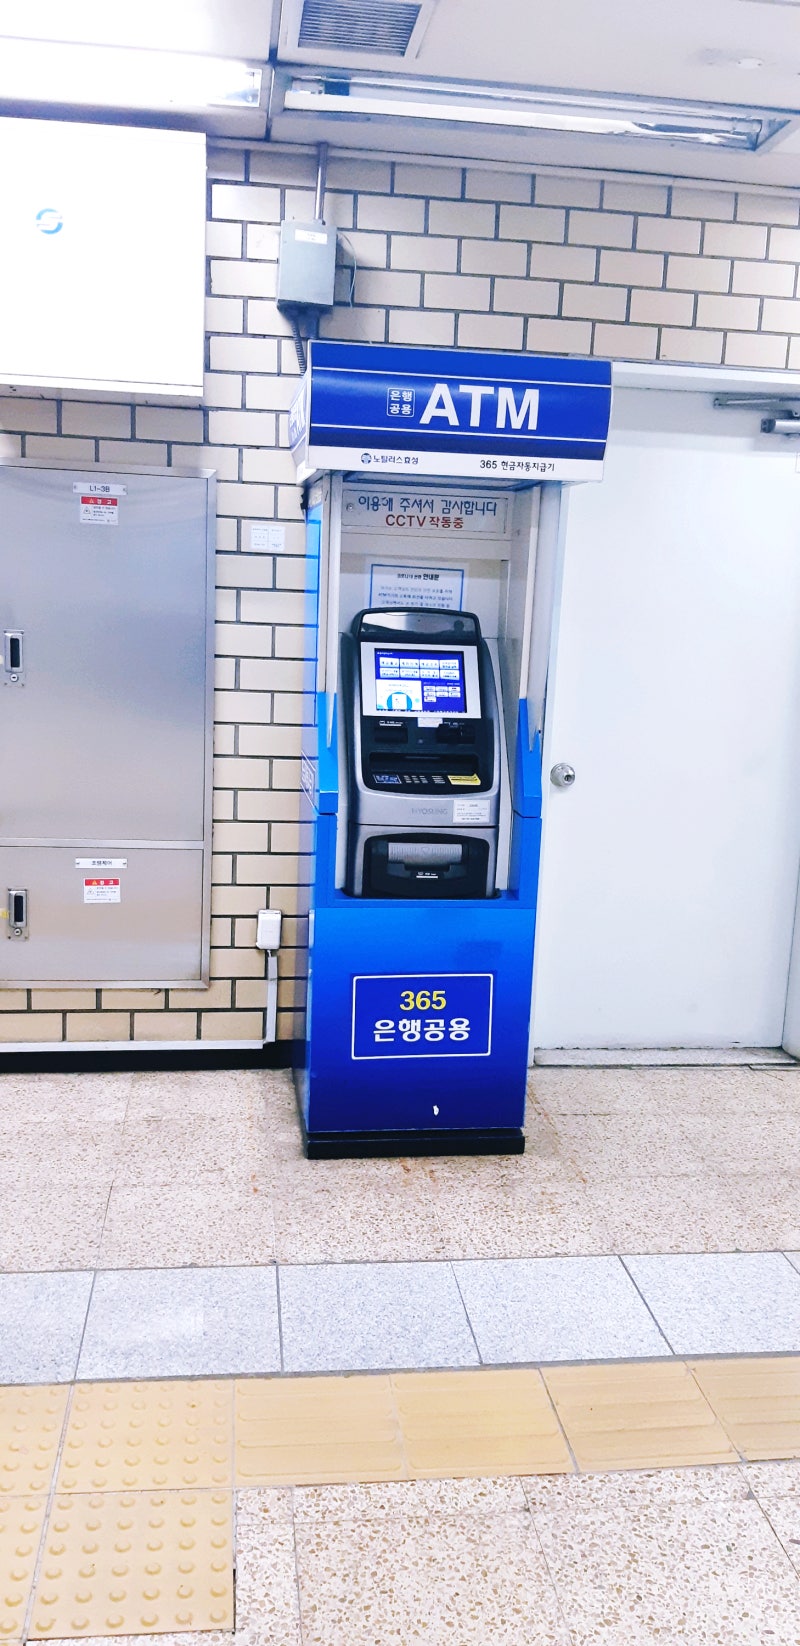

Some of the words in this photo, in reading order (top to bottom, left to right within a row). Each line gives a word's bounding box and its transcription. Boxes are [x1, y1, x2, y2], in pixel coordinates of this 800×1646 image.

[390, 390, 413, 403] 은행
[389, 403, 412, 415] 공용
[419, 383, 540, 431] ATM
[480, 460, 498, 469] 365
[500, 460, 555, 473] 현금자동지급기
[400, 497, 434, 514] 주셔서
[441, 499, 498, 516] 감사합니다
[385, 514, 426, 527] CCTV
[429, 516, 464, 529] 작동중
[399, 990, 447, 1011] 365
[373, 1017, 471, 1043] 은행공용
